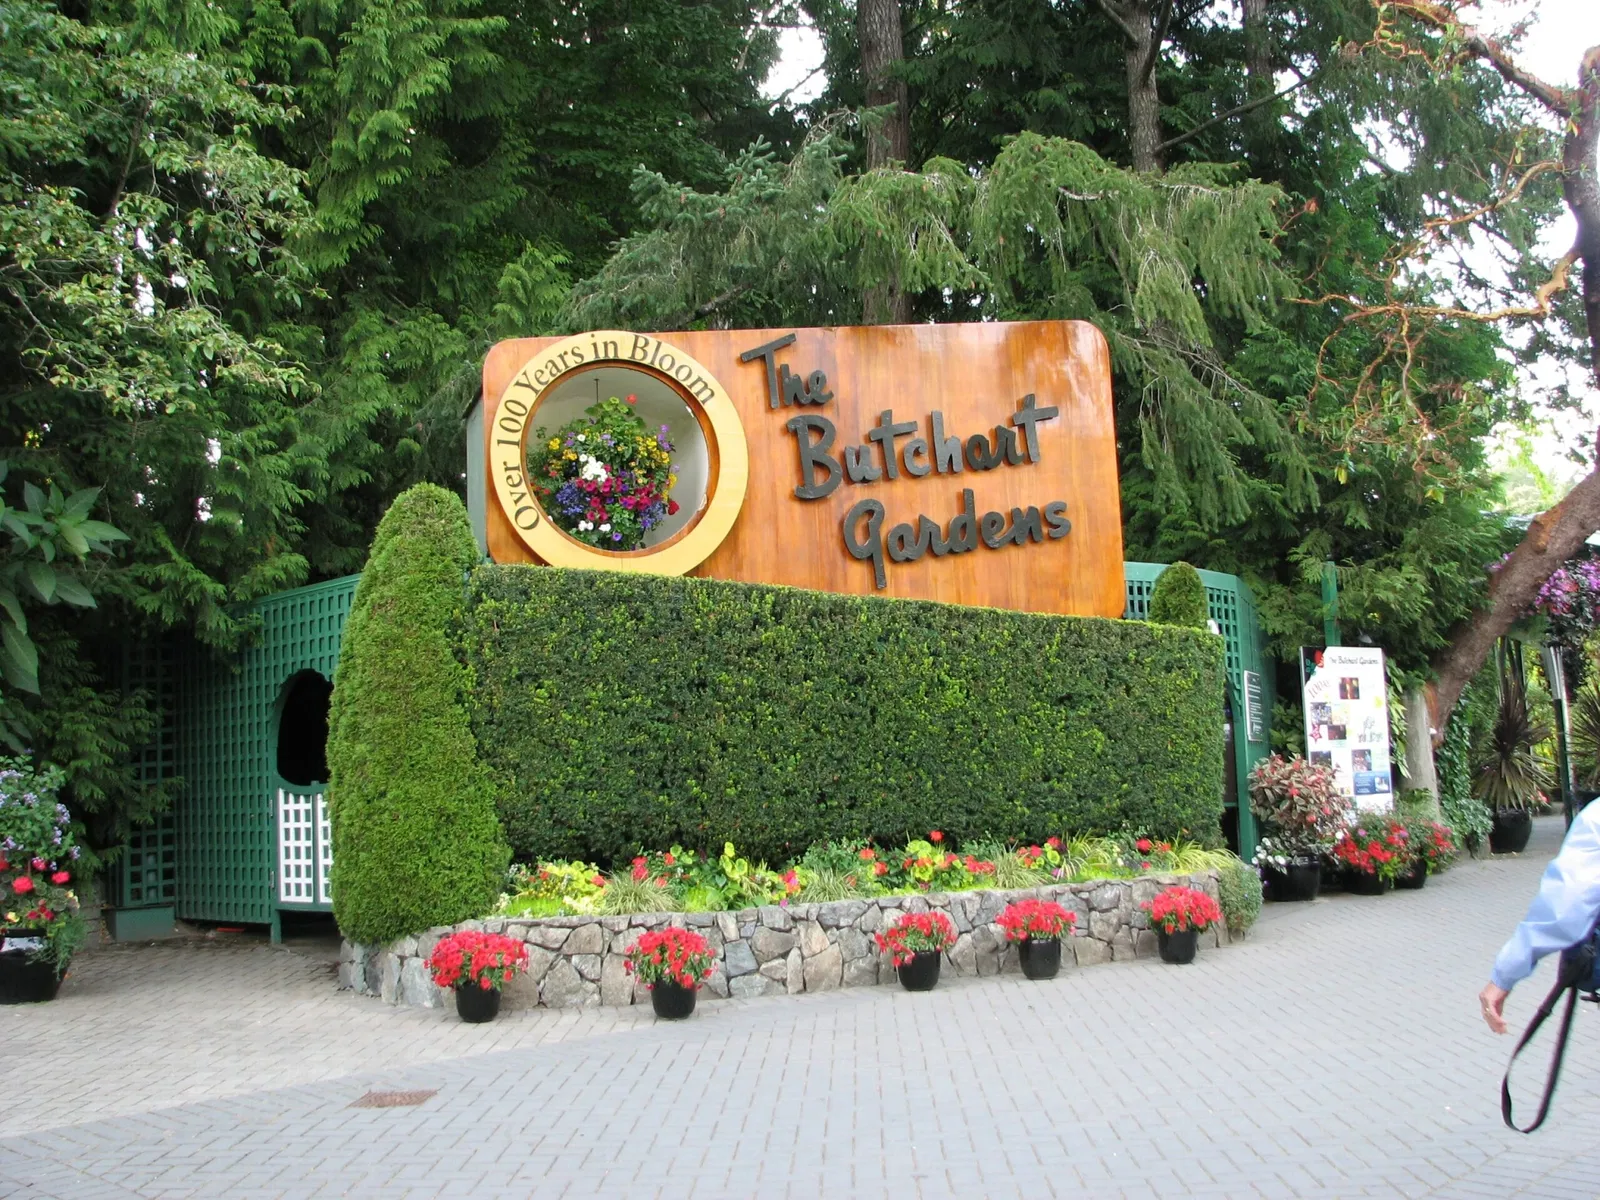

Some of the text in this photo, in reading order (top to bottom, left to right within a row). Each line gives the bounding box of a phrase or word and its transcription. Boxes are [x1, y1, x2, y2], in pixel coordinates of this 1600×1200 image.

[740, 333, 834, 409] The
[497, 333, 715, 531] Over 100 Years in Bloom
[786, 393, 1060, 500] Butchart
[843, 488, 1072, 589] Gardens
